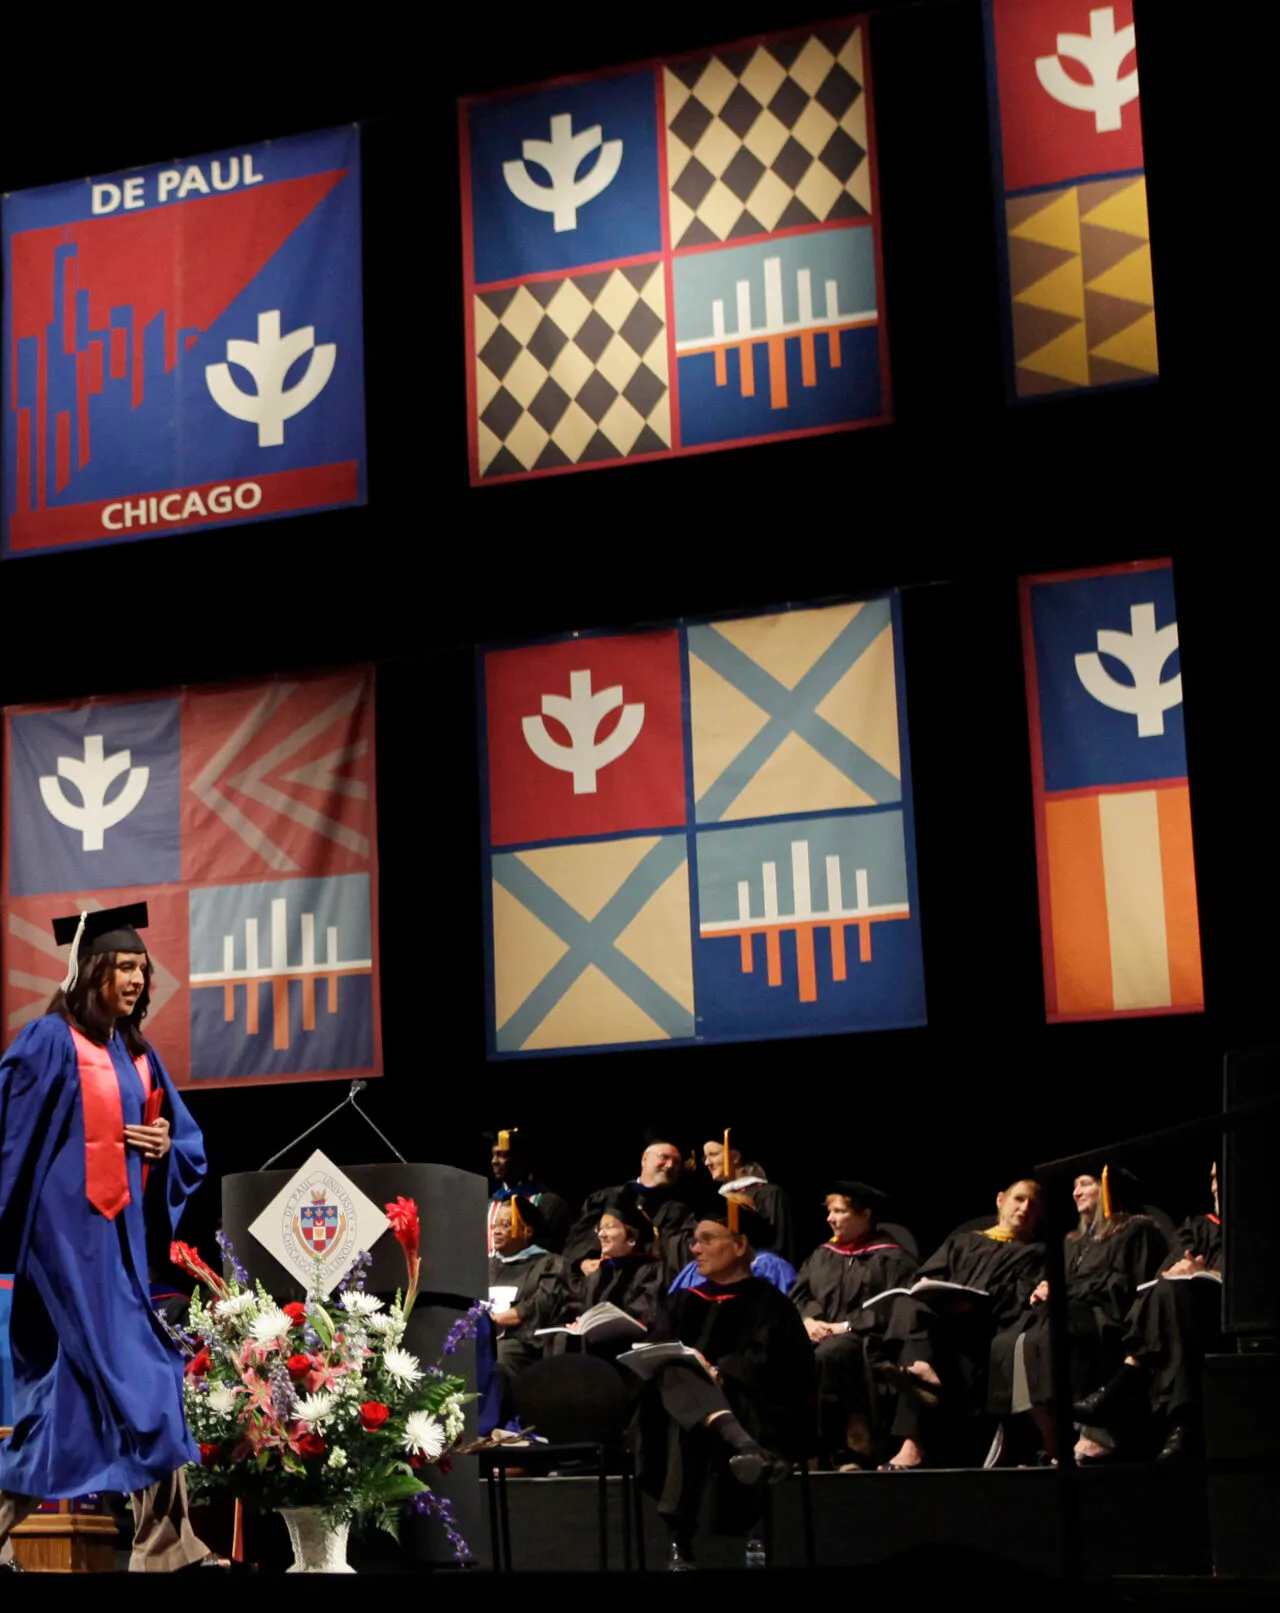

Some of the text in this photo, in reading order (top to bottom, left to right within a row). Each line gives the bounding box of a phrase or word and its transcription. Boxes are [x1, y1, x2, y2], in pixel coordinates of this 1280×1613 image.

[91, 154, 264, 215] DE PAUL
[101, 482, 262, 530] CHICAGO
[291, 1179, 314, 1200] PAUL
